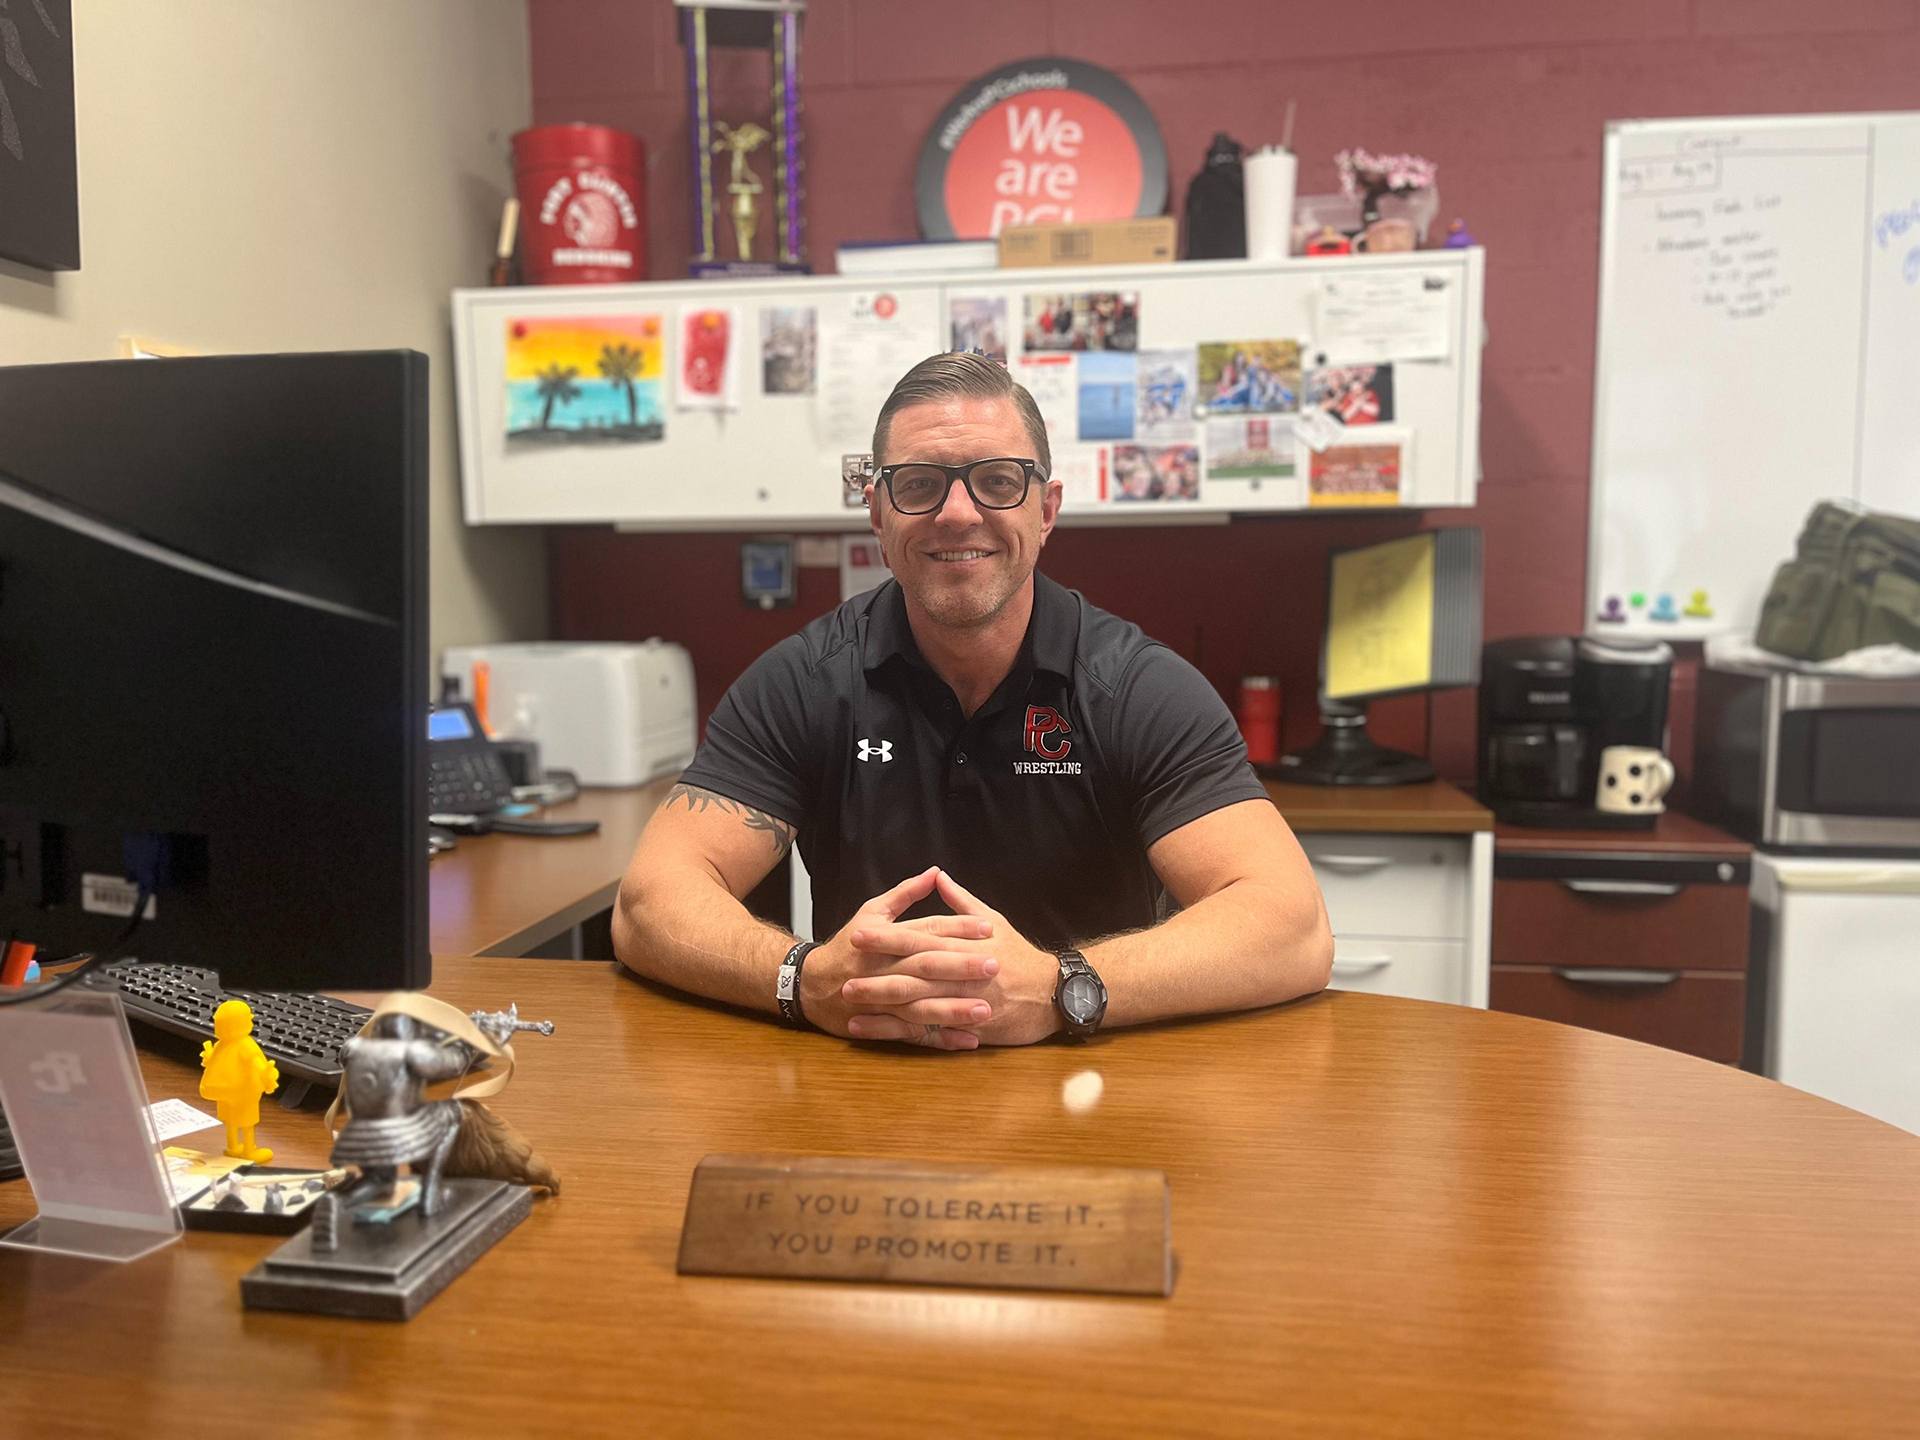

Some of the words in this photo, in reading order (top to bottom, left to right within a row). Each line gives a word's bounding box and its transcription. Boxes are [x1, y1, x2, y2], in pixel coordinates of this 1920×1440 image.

[1006, 104, 1084, 157] We
[994, 158, 1079, 201] are
[1012, 761, 1082, 775] WRESTLING
[745, 1191, 773, 1211] IF
[796, 1194, 859, 1217] YOU
[883, 1198, 1043, 1222] TOLERATE
[1065, 1204, 1106, 1228] IT.
[768, 1232, 834, 1254] YOU
[854, 1237, 1011, 1263] PROMOTE
[1034, 1244, 1077, 1267] IT.
